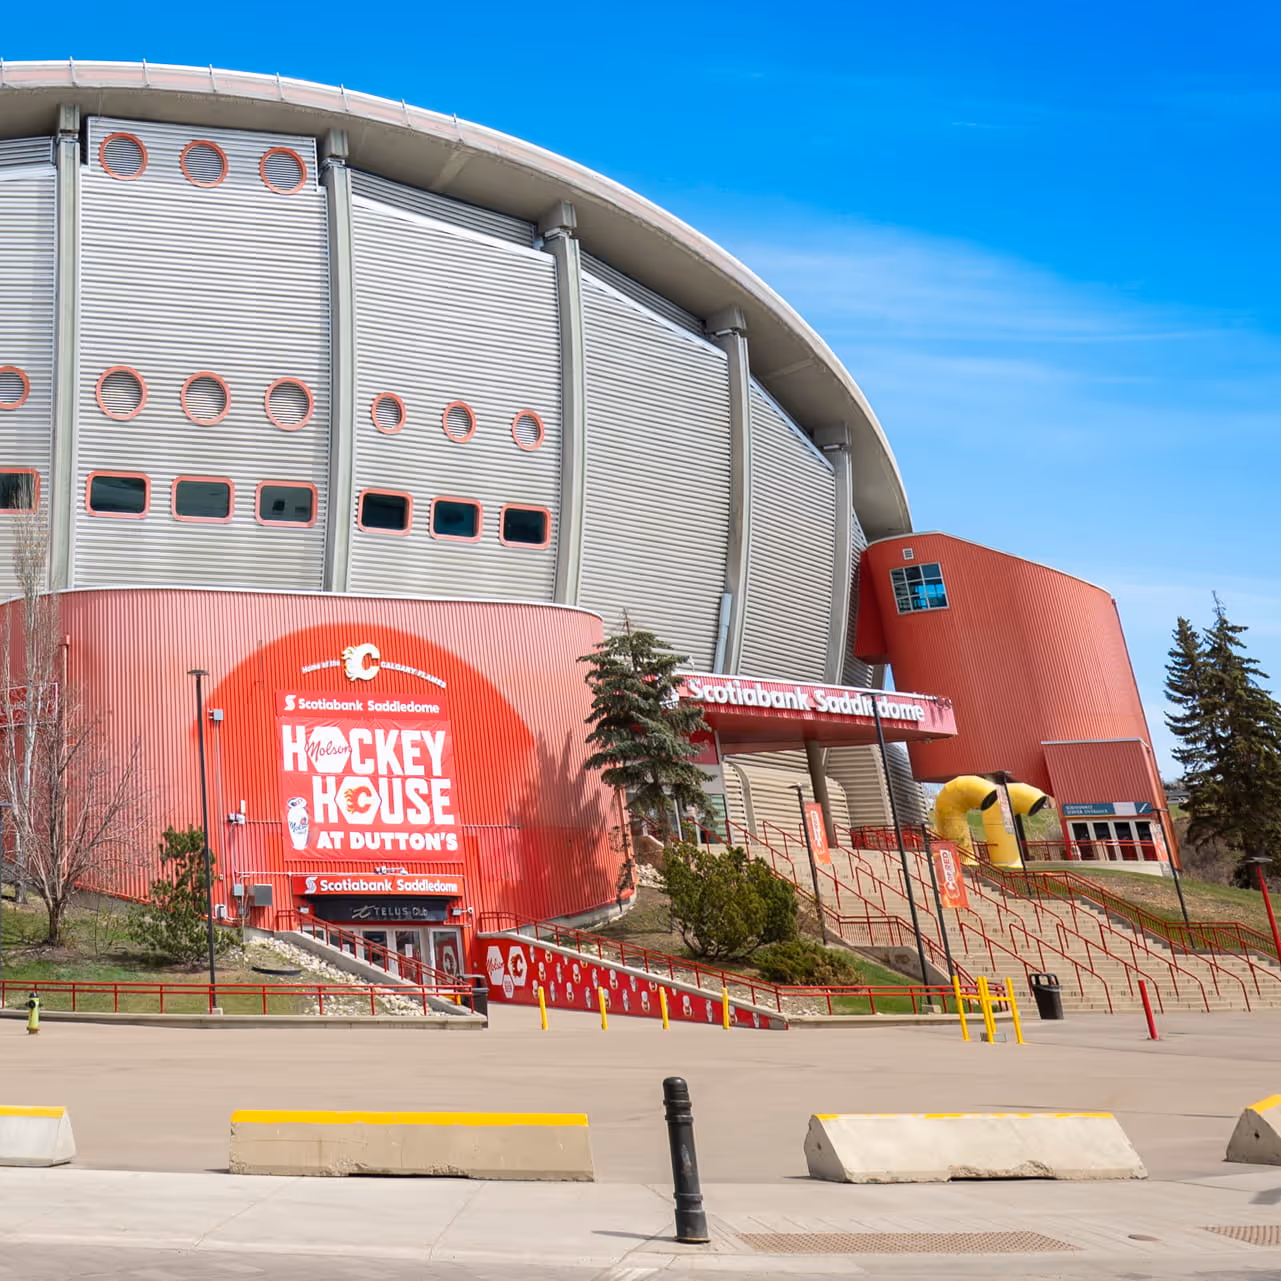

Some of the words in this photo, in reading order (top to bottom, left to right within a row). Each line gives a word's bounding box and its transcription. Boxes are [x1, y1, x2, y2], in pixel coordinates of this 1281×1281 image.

[688, 679, 812, 711] Scotiabank
[298, 698, 363, 711] Scotiabank
[368, 700, 440, 713] Saddledome
[304, 740, 353, 762] Molson
[317, 832, 345, 849] AT
[350, 832, 459, 850] DUTTON'S
[943, 851, 951, 870] RED
[320, 879, 393, 891] Scotiabank
[374, 906, 408, 917] TELUS
